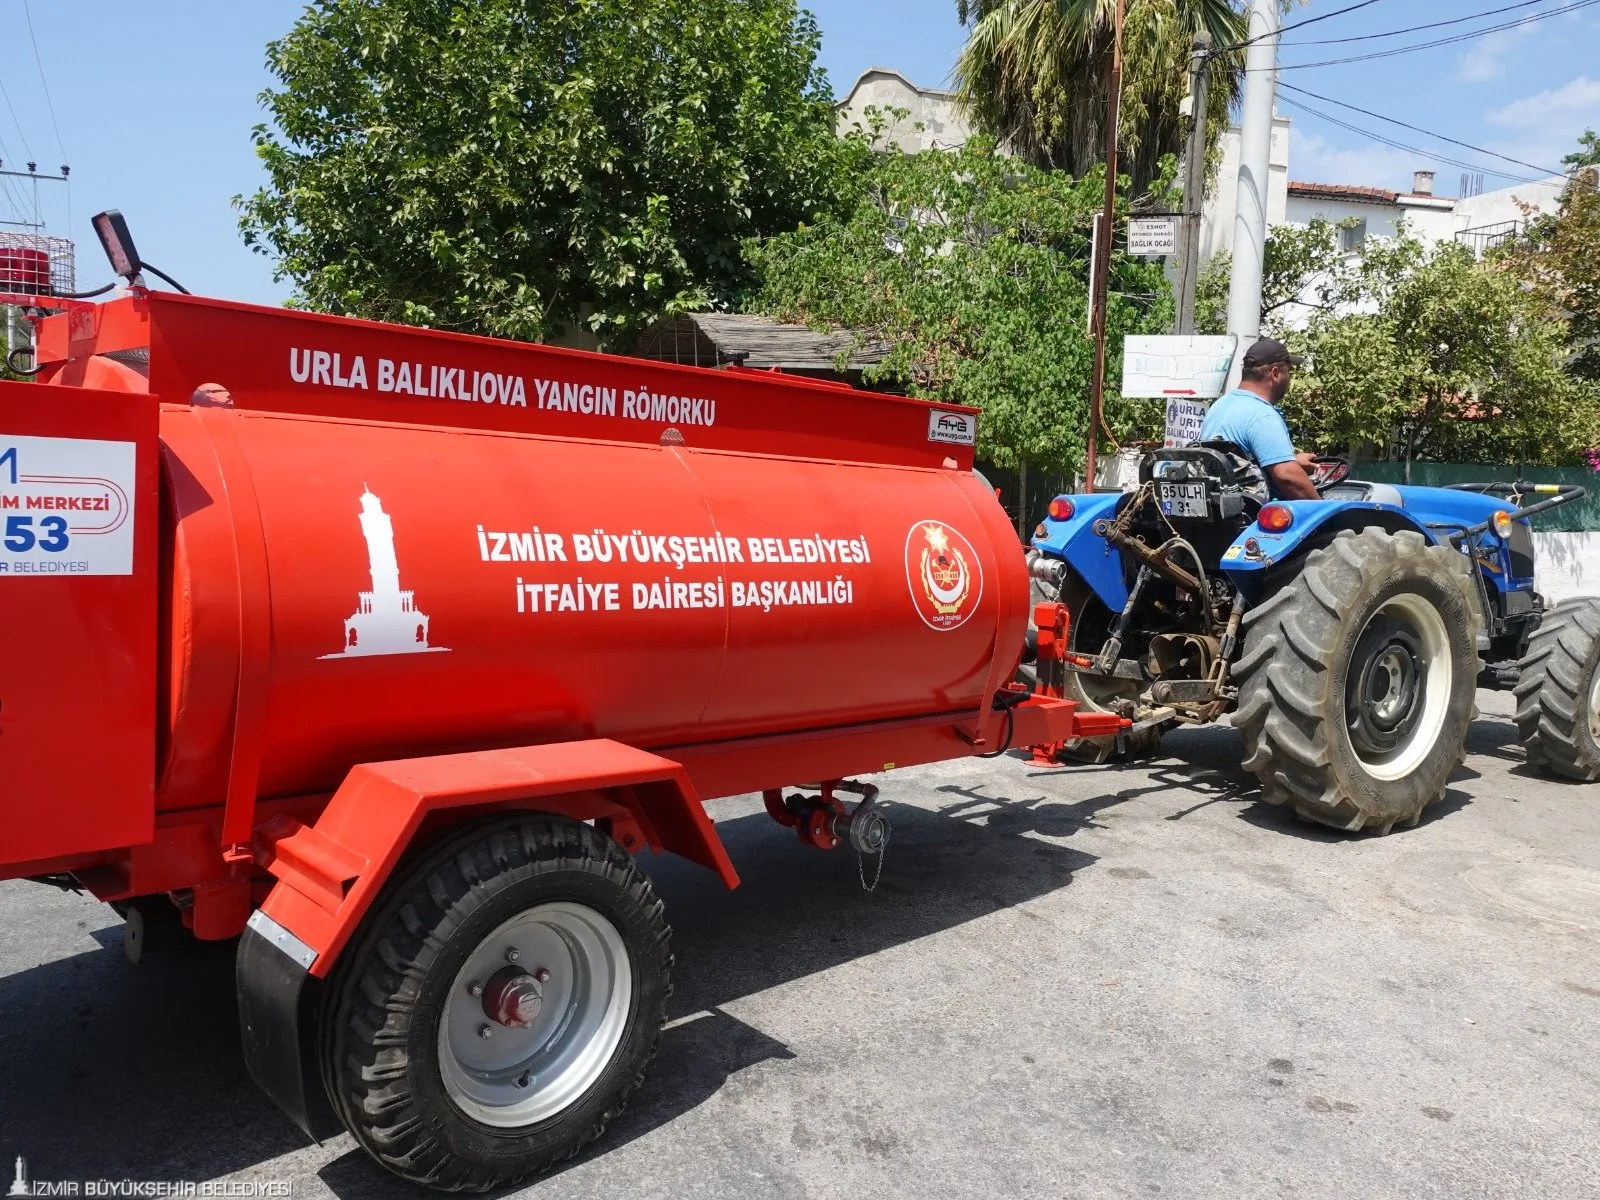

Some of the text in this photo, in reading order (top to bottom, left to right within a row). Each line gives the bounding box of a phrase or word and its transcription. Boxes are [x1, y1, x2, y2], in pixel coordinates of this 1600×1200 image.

[1130, 239, 1174, 247] SAĞLIK OCAĞI
[289, 347, 716, 427] URLA BALIKLIOVA YANGIN RÖMORKU
[1179, 404, 1206, 417] URLA
[26, 493, 110, 511] MERKEZİ
[476, 524, 871, 569] İZMİR BÜYÜKŞEHİR BELEDİYESİ
[14, 560, 89, 573] BELEDİYESİ
[516, 574, 853, 613] İTFAİYE DAİRESİ BAŞKANLIĞI
